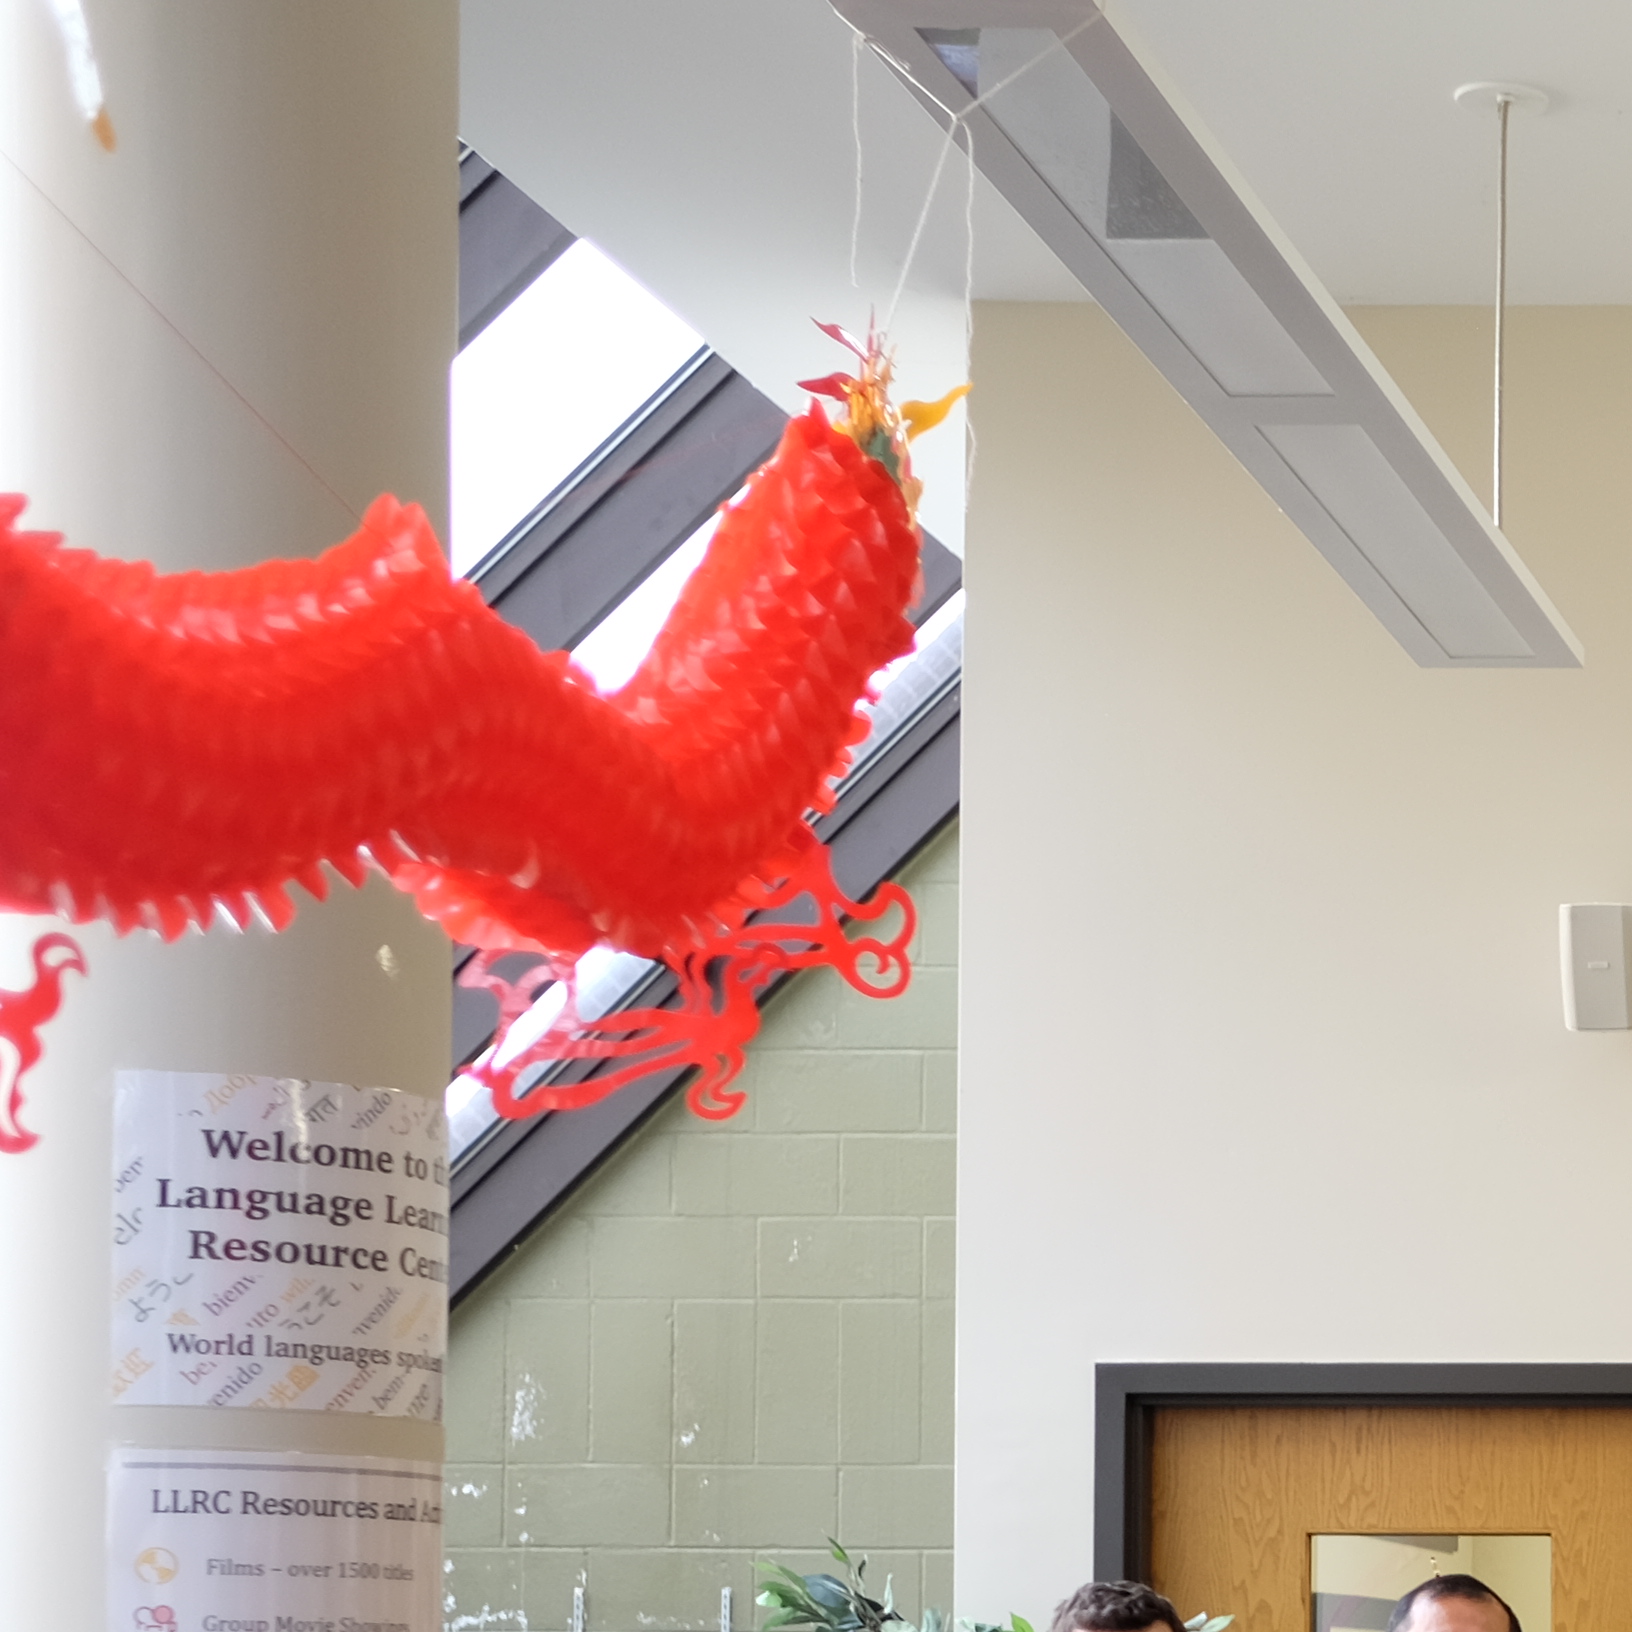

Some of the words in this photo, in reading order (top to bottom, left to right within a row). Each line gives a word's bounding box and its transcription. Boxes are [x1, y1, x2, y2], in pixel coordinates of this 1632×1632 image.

[202, 1129, 395, 1174] Welcome
[404, 1150, 429, 1182] to
[156, 1178, 373, 1227] Language
[188, 1230, 388, 1272] Resource
[166, 1332, 254, 1358] World
[264, 1335, 390, 1368] languages
[151, 1489, 232, 1515] LLRC
[240, 1490, 379, 1520] Resources
[384, 1497, 417, 1522] and
[206, 1558, 265, 1578] Films
[287, 1563, 333, 1579] over
[338, 1562, 381, 1580] 1500
